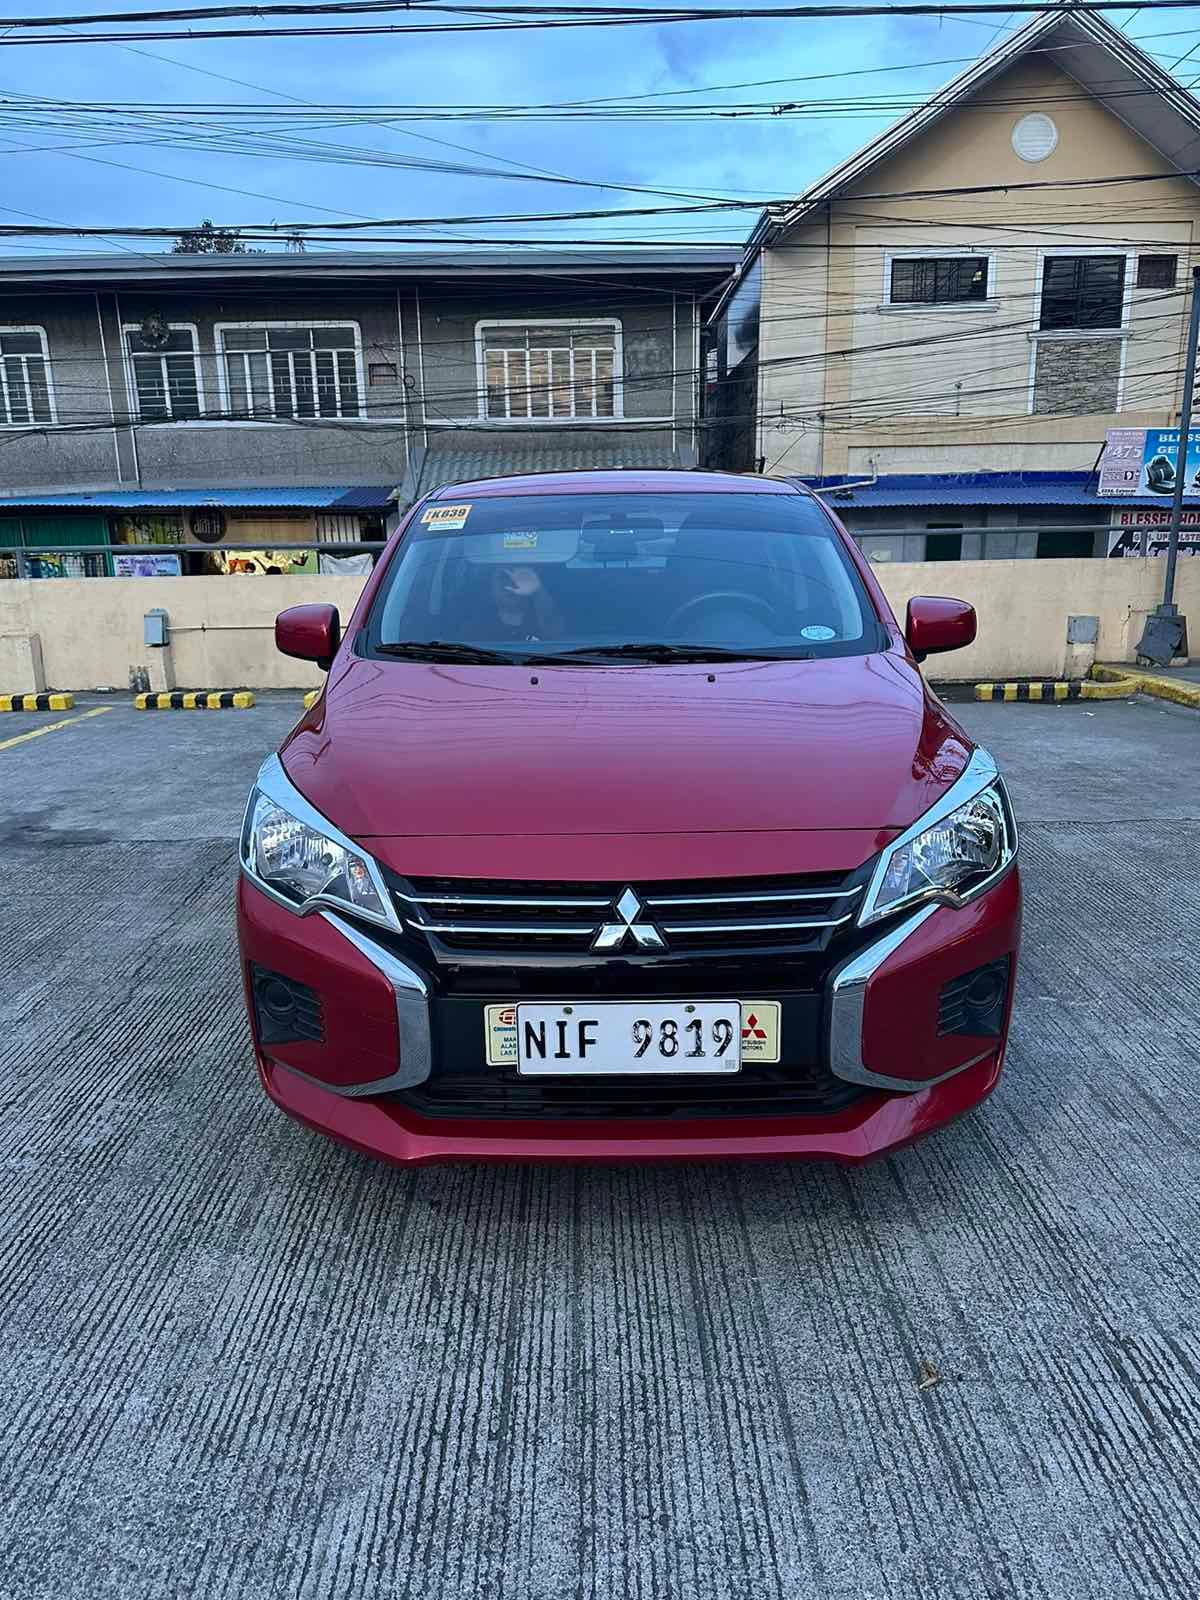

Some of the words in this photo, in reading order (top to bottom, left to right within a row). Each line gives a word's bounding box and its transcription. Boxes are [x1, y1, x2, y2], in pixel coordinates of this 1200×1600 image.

[1159, 433, 1200, 442] BLSS
[525, 1021, 599, 1058] NIF
[632, 1019, 734, 1058] 9819
